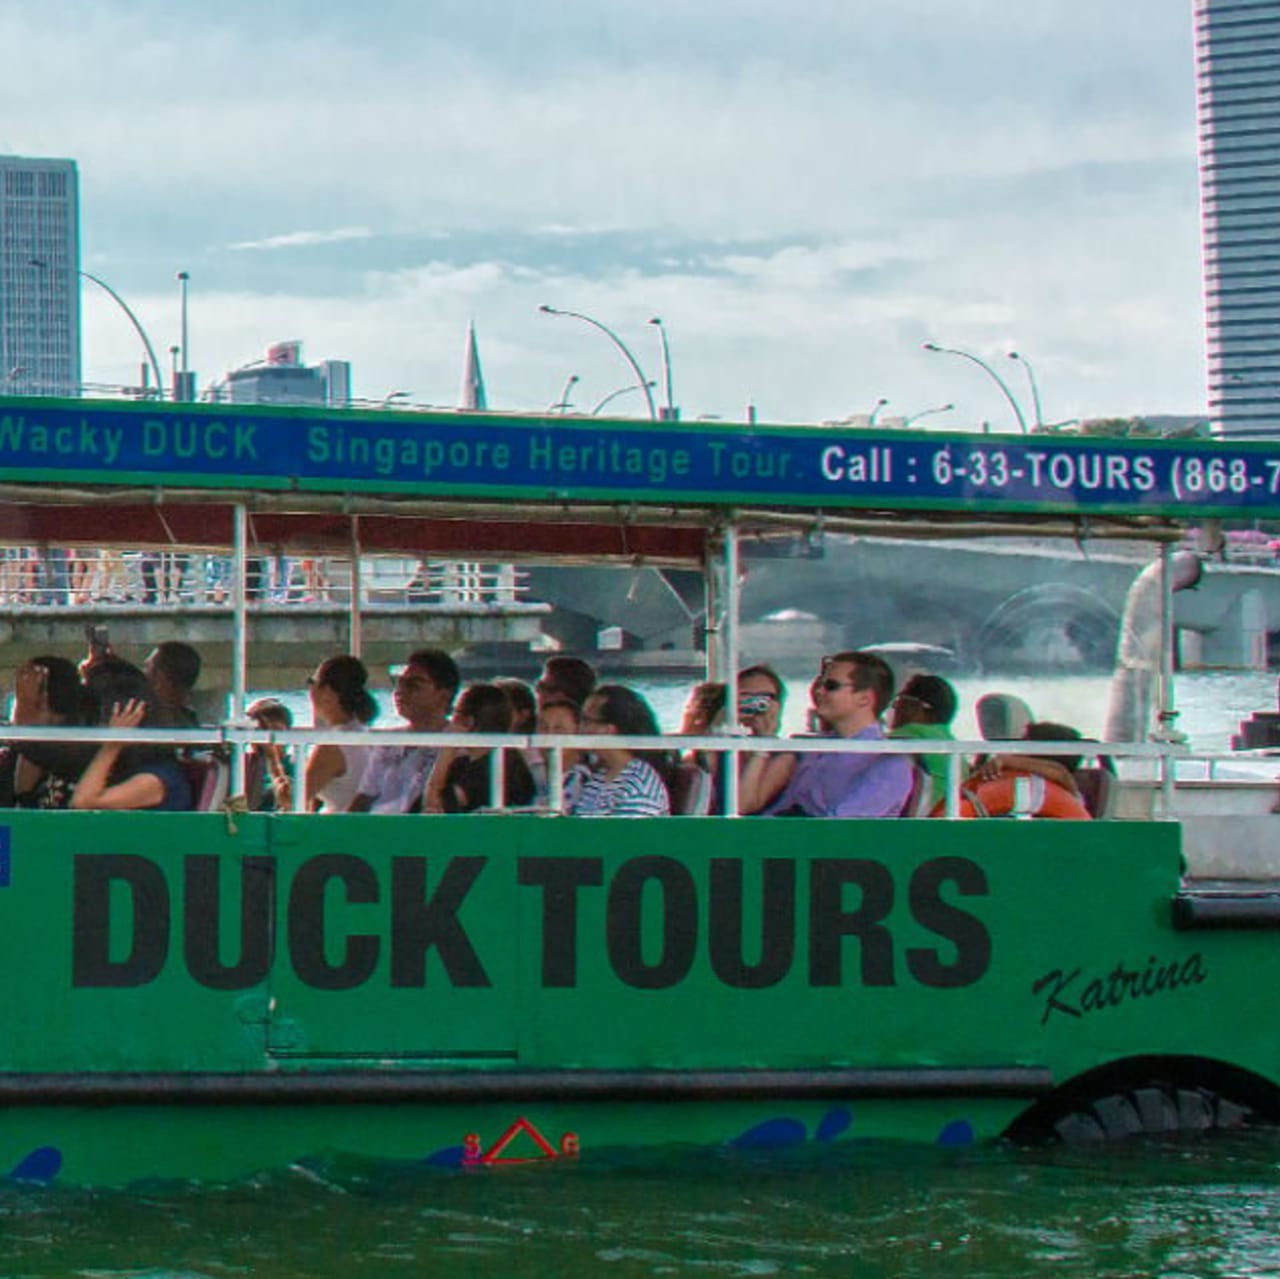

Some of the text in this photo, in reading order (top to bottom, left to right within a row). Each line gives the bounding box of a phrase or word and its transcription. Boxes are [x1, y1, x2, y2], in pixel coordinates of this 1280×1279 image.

[142, 420, 259, 460] DUCK
[307, 426, 510, 474] Singapore
[529, 436, 690, 483] Heritage
[820, 445, 892, 483] Call
[932, 449, 1156, 491] 6-33-TOURS
[72, 853, 992, 991] DUCK TOURS
[1032, 952, 1208, 1025] Katrina
